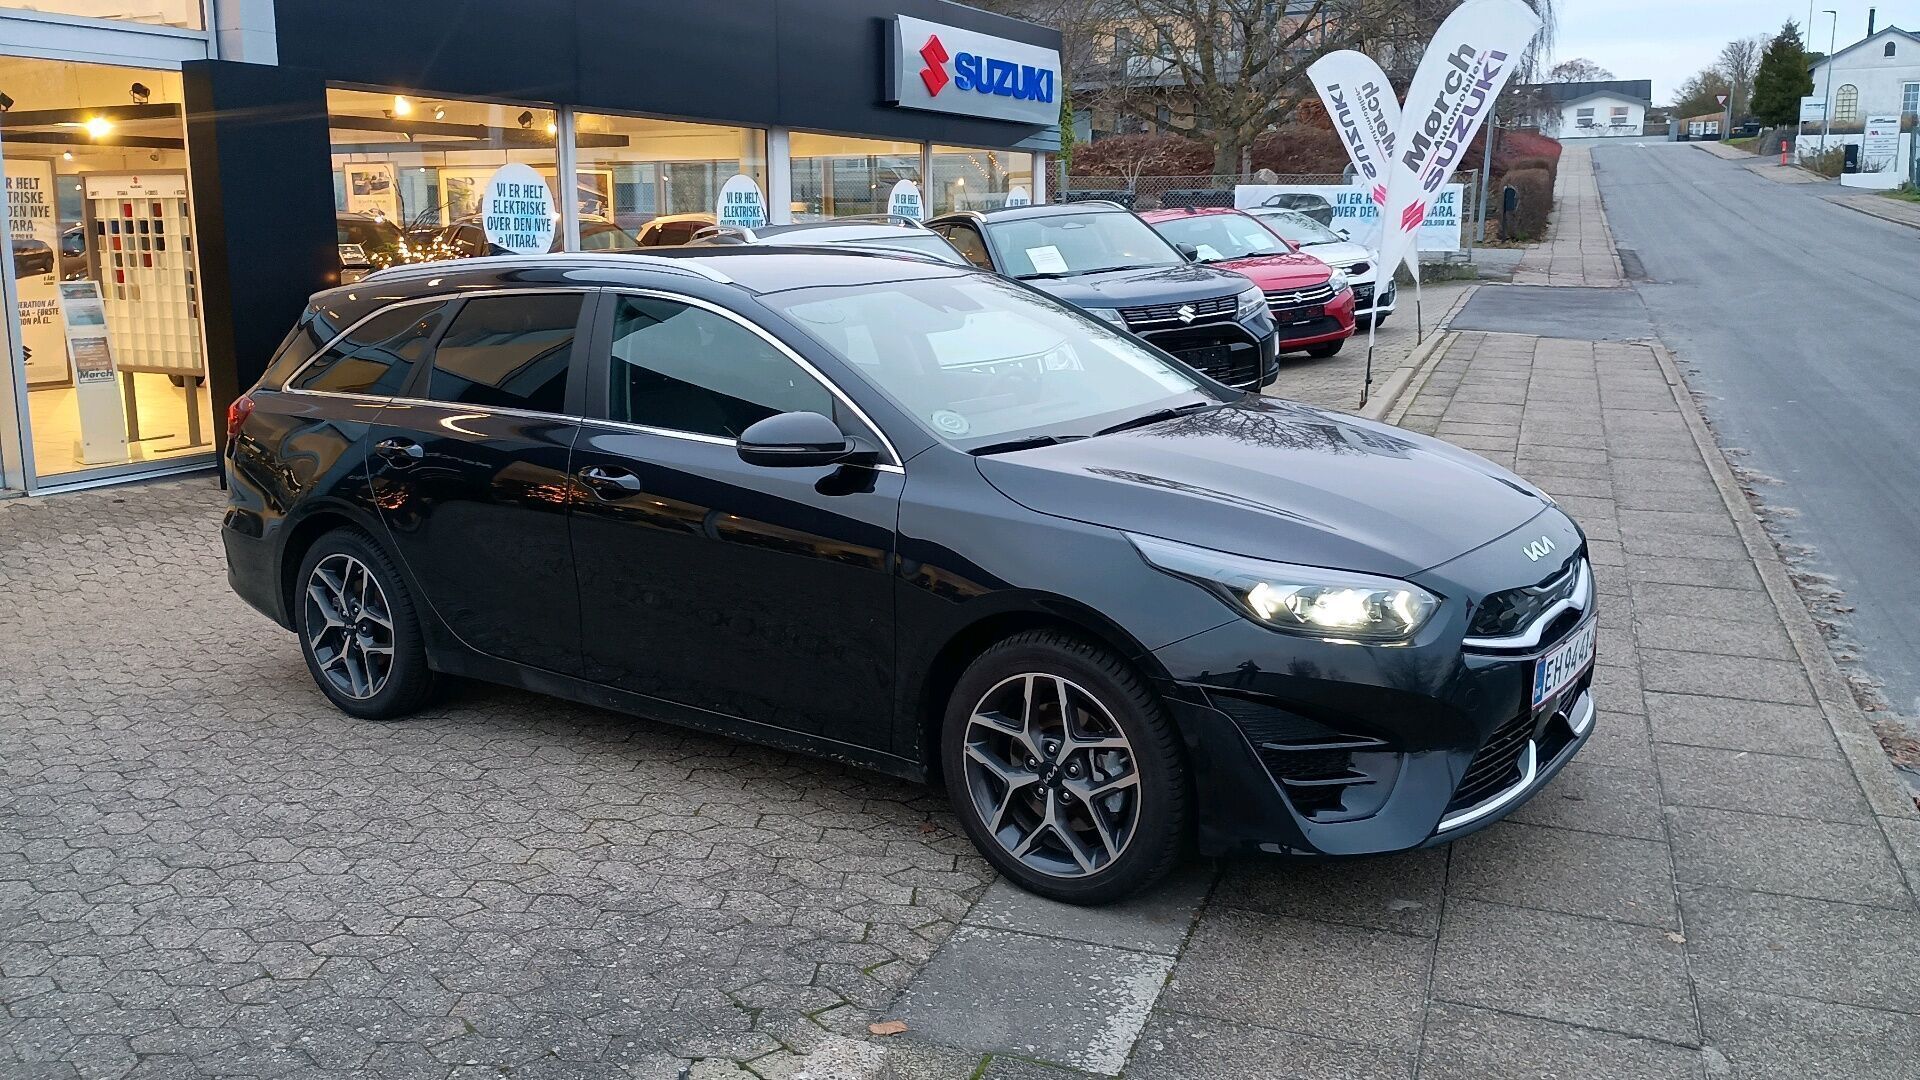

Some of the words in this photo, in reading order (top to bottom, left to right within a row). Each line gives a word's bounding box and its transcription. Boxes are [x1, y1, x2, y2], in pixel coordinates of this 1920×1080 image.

[955, 52, 1053, 103] SUZUKI
[1402, 44, 1476, 173] Mørch
[1434, 58, 1482, 151] Automobiler
[1424, 50, 1508, 193] SUZUKI
[16, 177, 40, 189] HELT
[7, 191, 43, 203] TRISKE
[496, 183, 506, 197] VI
[509, 184, 520, 198] ER
[523, 185, 543, 199] HELT
[726, 192, 733, 203] VI
[735, 192, 743, 203] ER
[744, 192, 758, 203] HELT
[1336, 193, 1347, 204] VI
[1350, 193, 1362, 204] ER
[30, 205, 50, 217] NYE
[493, 200, 546, 215] ELEKTRISKE
[723, 205, 761, 217] ELEKTRISKE
[1331, 206, 1357, 217] OVER
[487, 216, 511, 231] OVER
[514, 217, 531, 231] DEN
[535, 218, 551, 232] NYE
[505, 234, 540, 248] VITARA.
[1544, 652, 1564, 693] EH
